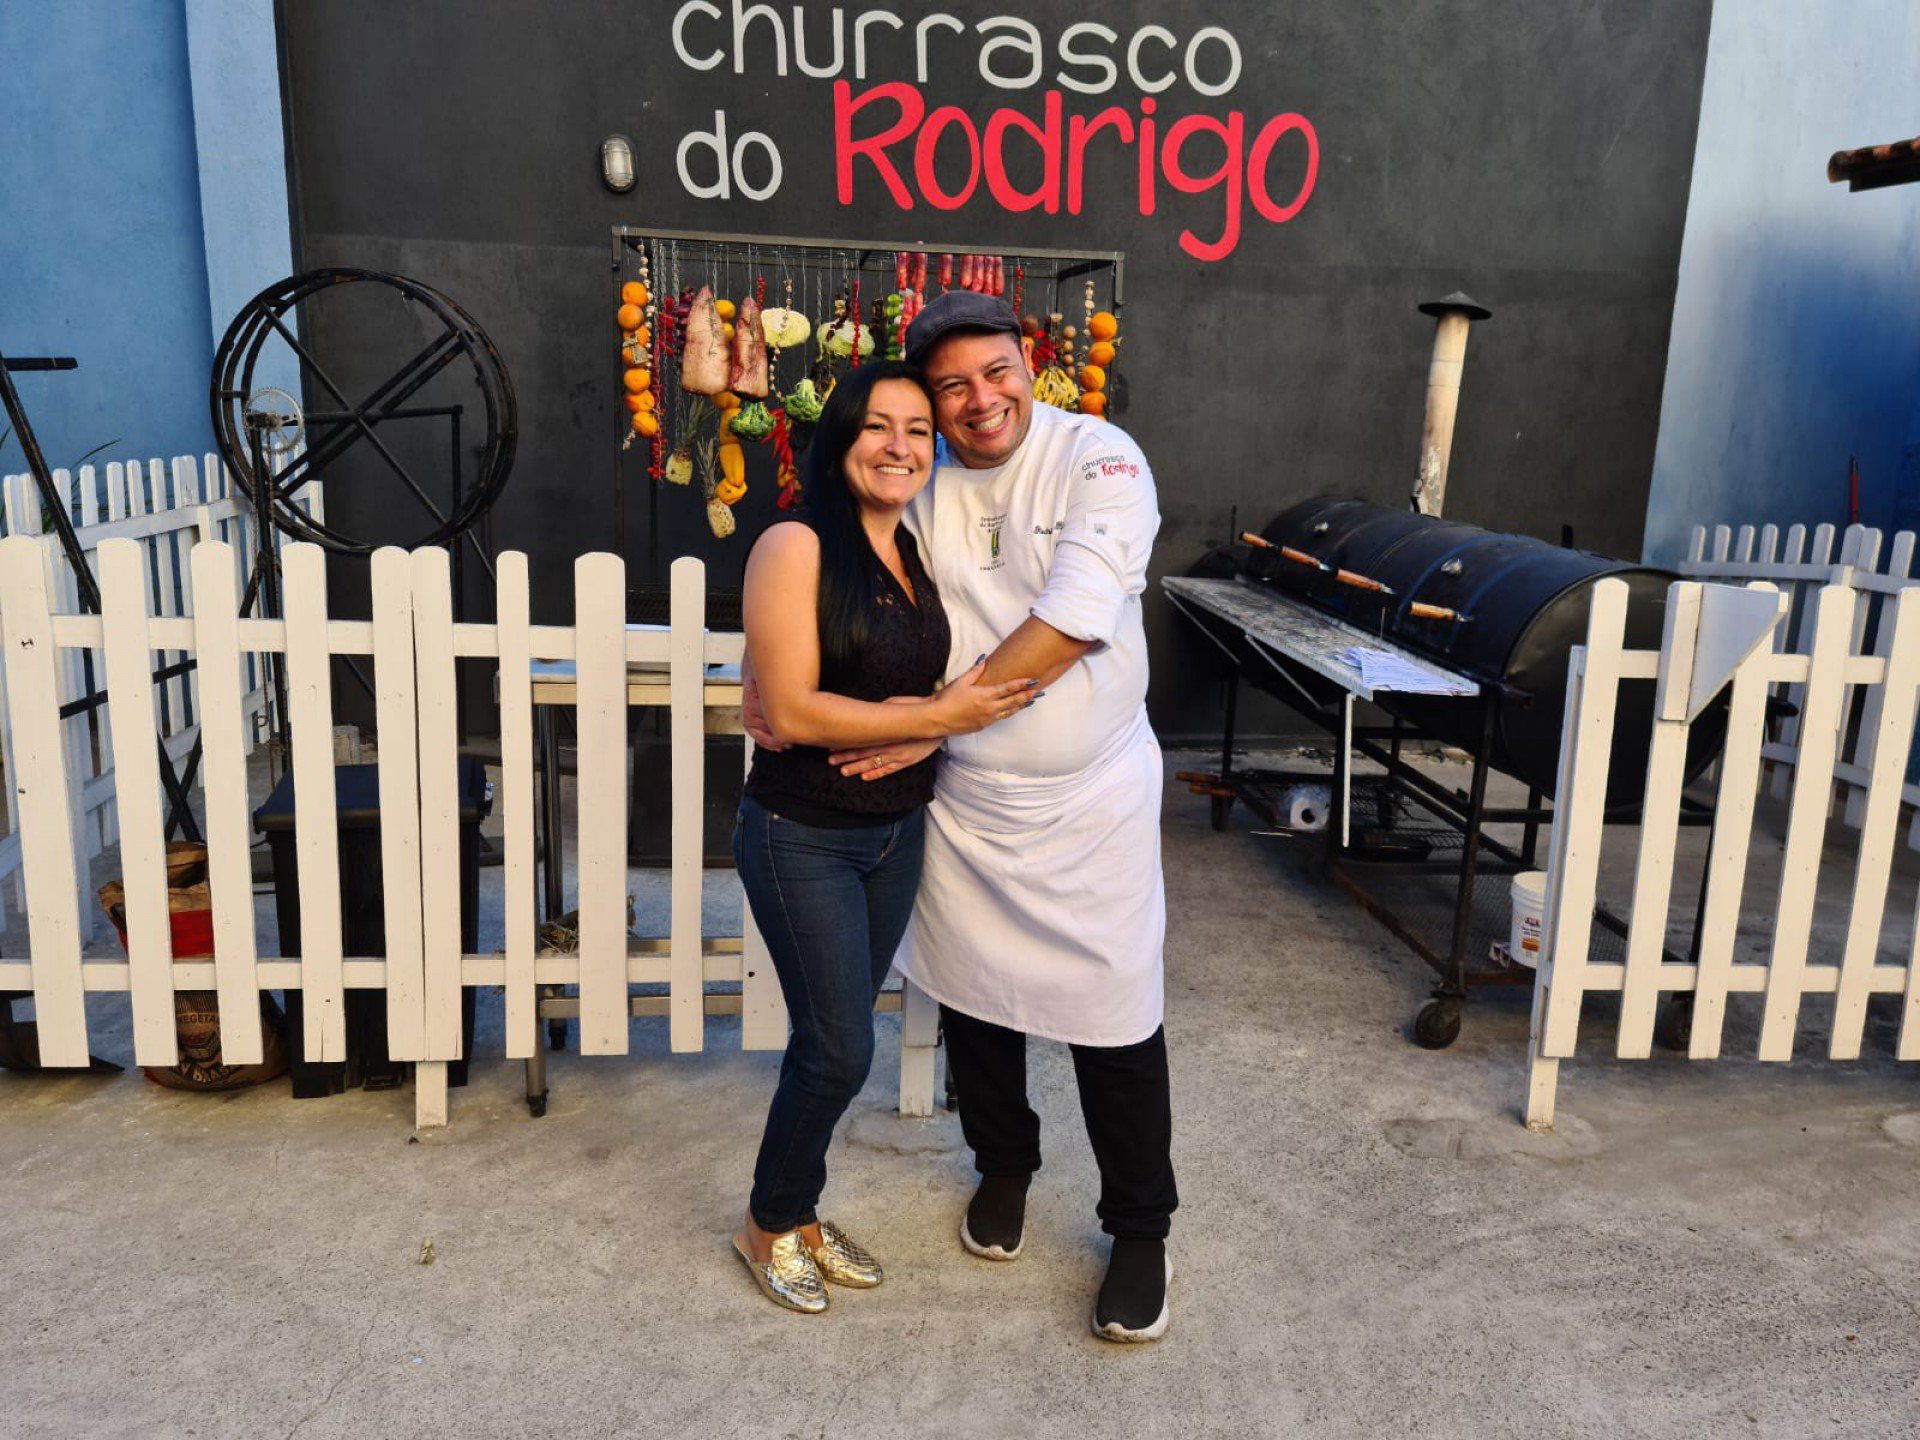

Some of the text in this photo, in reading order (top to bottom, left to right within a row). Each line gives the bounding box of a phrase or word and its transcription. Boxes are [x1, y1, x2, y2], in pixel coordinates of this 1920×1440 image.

[671, 0, 1244, 97] churrasco
[676, 79, 1320, 262] do Rodrigo
[1085, 471, 1097, 480] do
